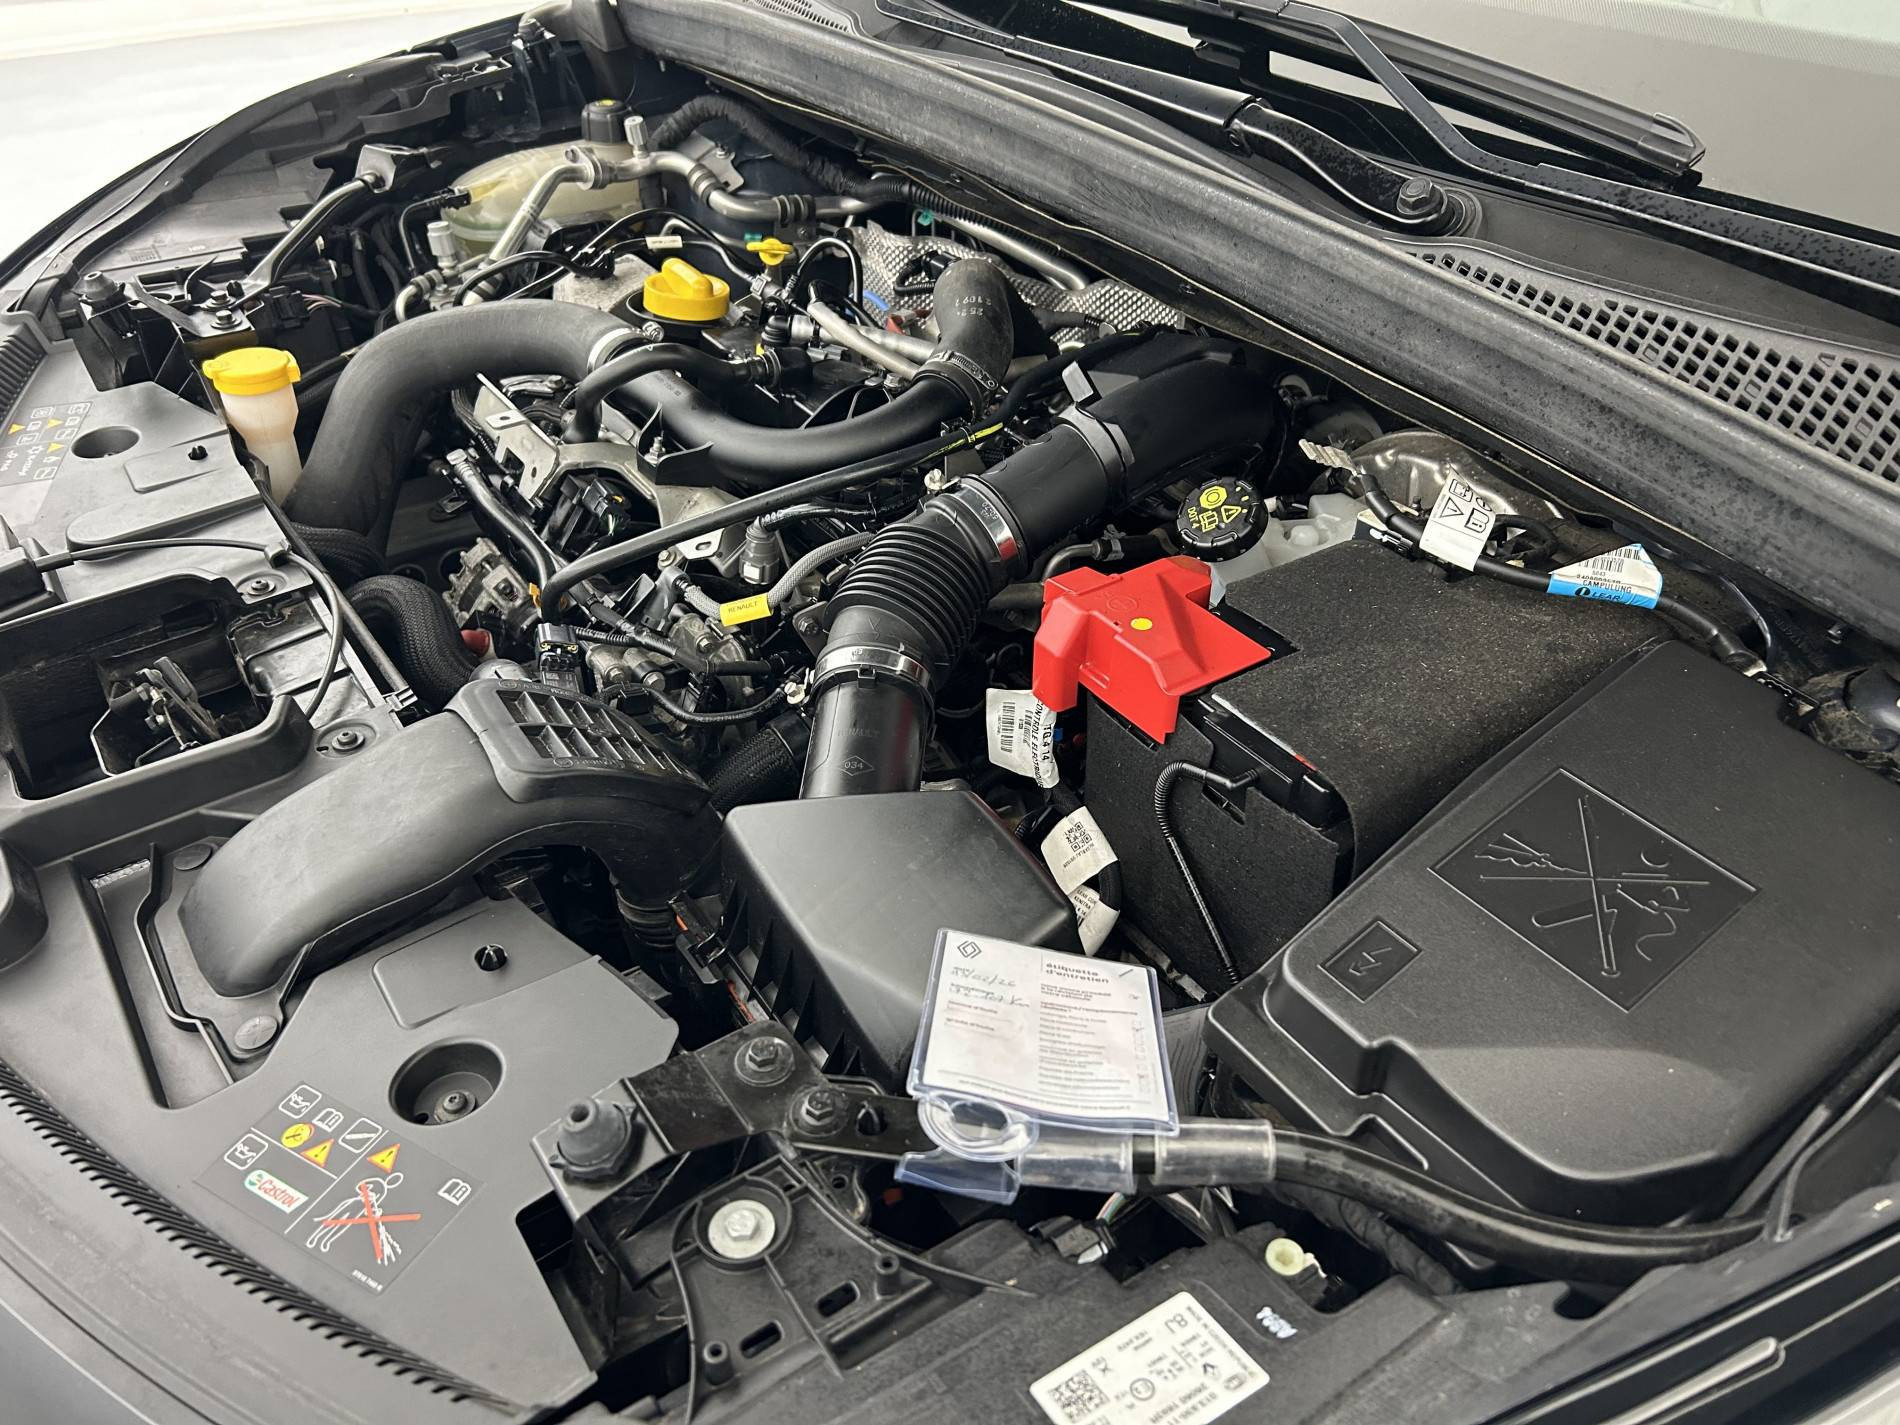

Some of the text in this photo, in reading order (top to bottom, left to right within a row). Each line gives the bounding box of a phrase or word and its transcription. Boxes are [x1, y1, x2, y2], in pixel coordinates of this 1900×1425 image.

[1582, 579, 1632, 594] CAMPULUNG
[1591, 591, 1622, 602] LEAR
[728, 601, 759, 613] RENAULT
[257, 1179, 301, 1208] Castrol
